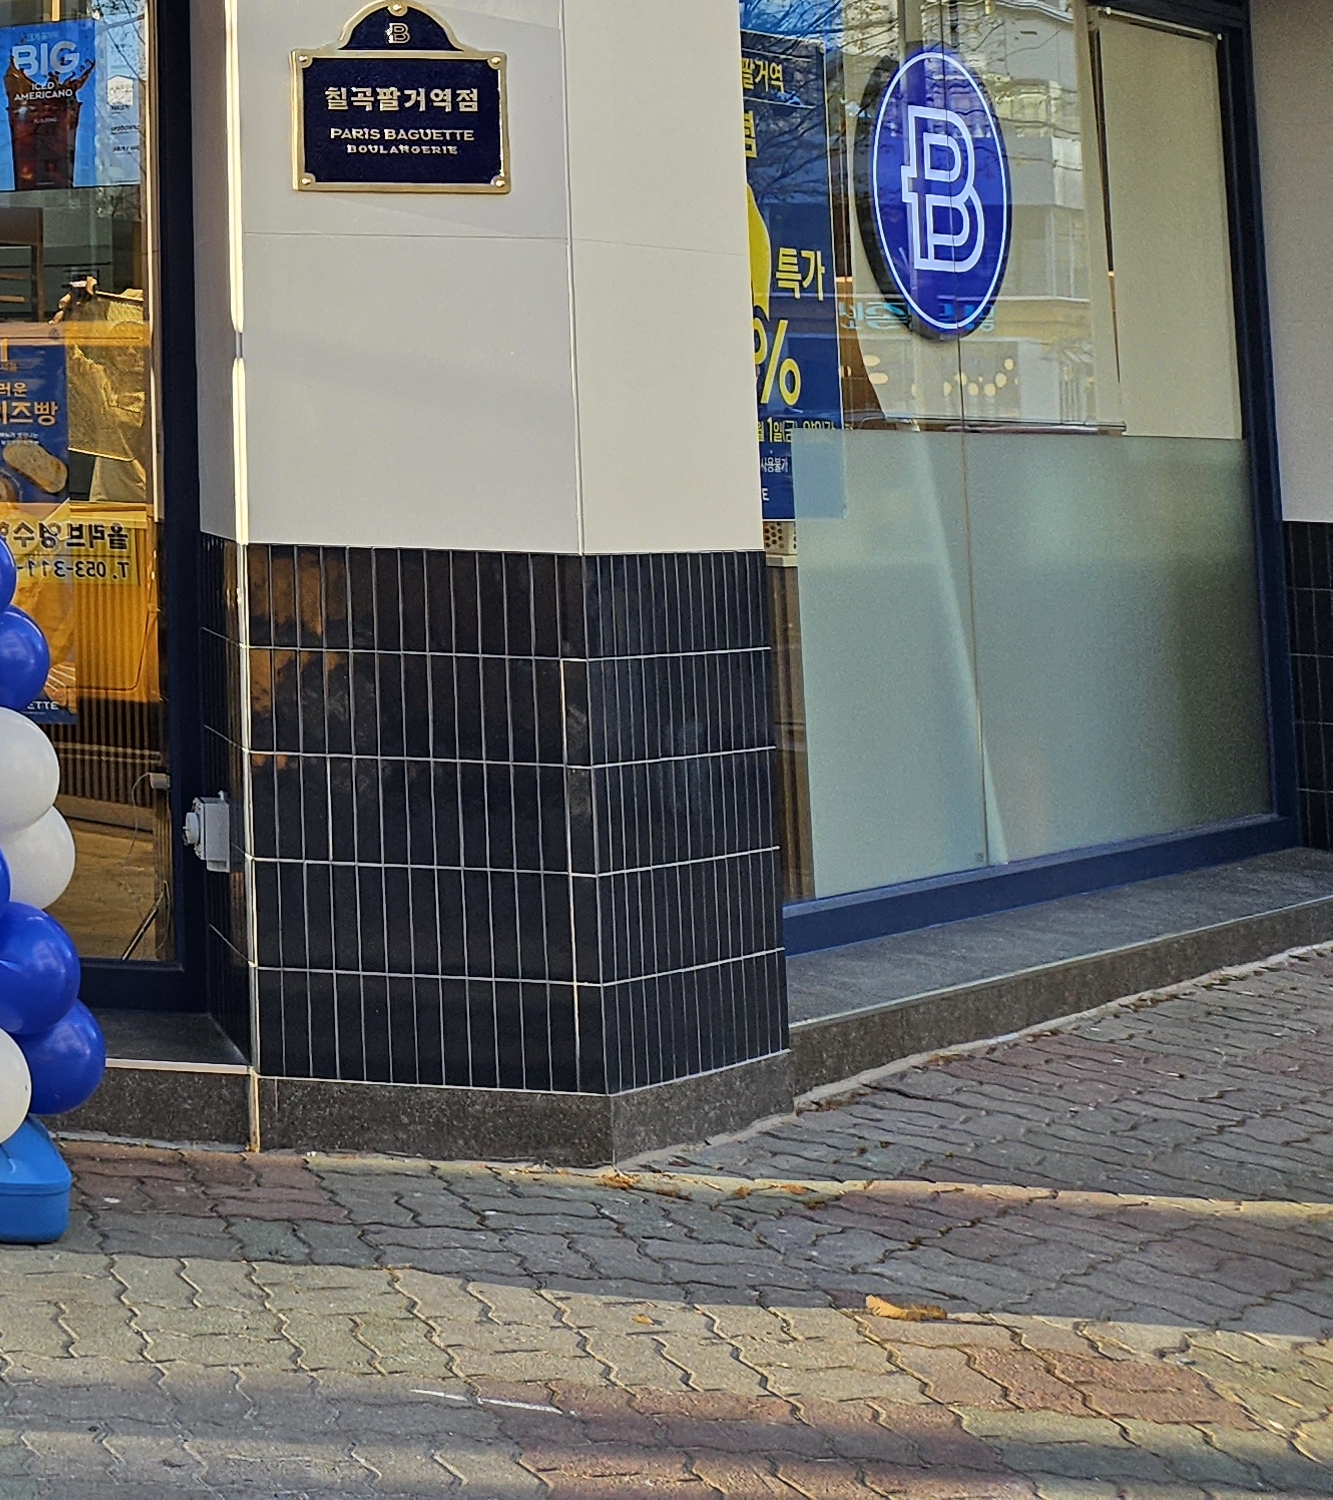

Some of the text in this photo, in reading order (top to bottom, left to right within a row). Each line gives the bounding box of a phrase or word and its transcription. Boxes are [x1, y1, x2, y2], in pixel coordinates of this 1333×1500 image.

[11, 40, 81, 77] BIG
[31, 81, 56, 92] ICED
[14, 88, 74, 102] AMERICANO
[324, 86, 479, 112] 칠곡팔거역점
[330, 127, 475, 141] PARIS BAGUETTE
[346, 144, 459, 155] BOULANGERIE
[775, 247, 826, 302] 특가
